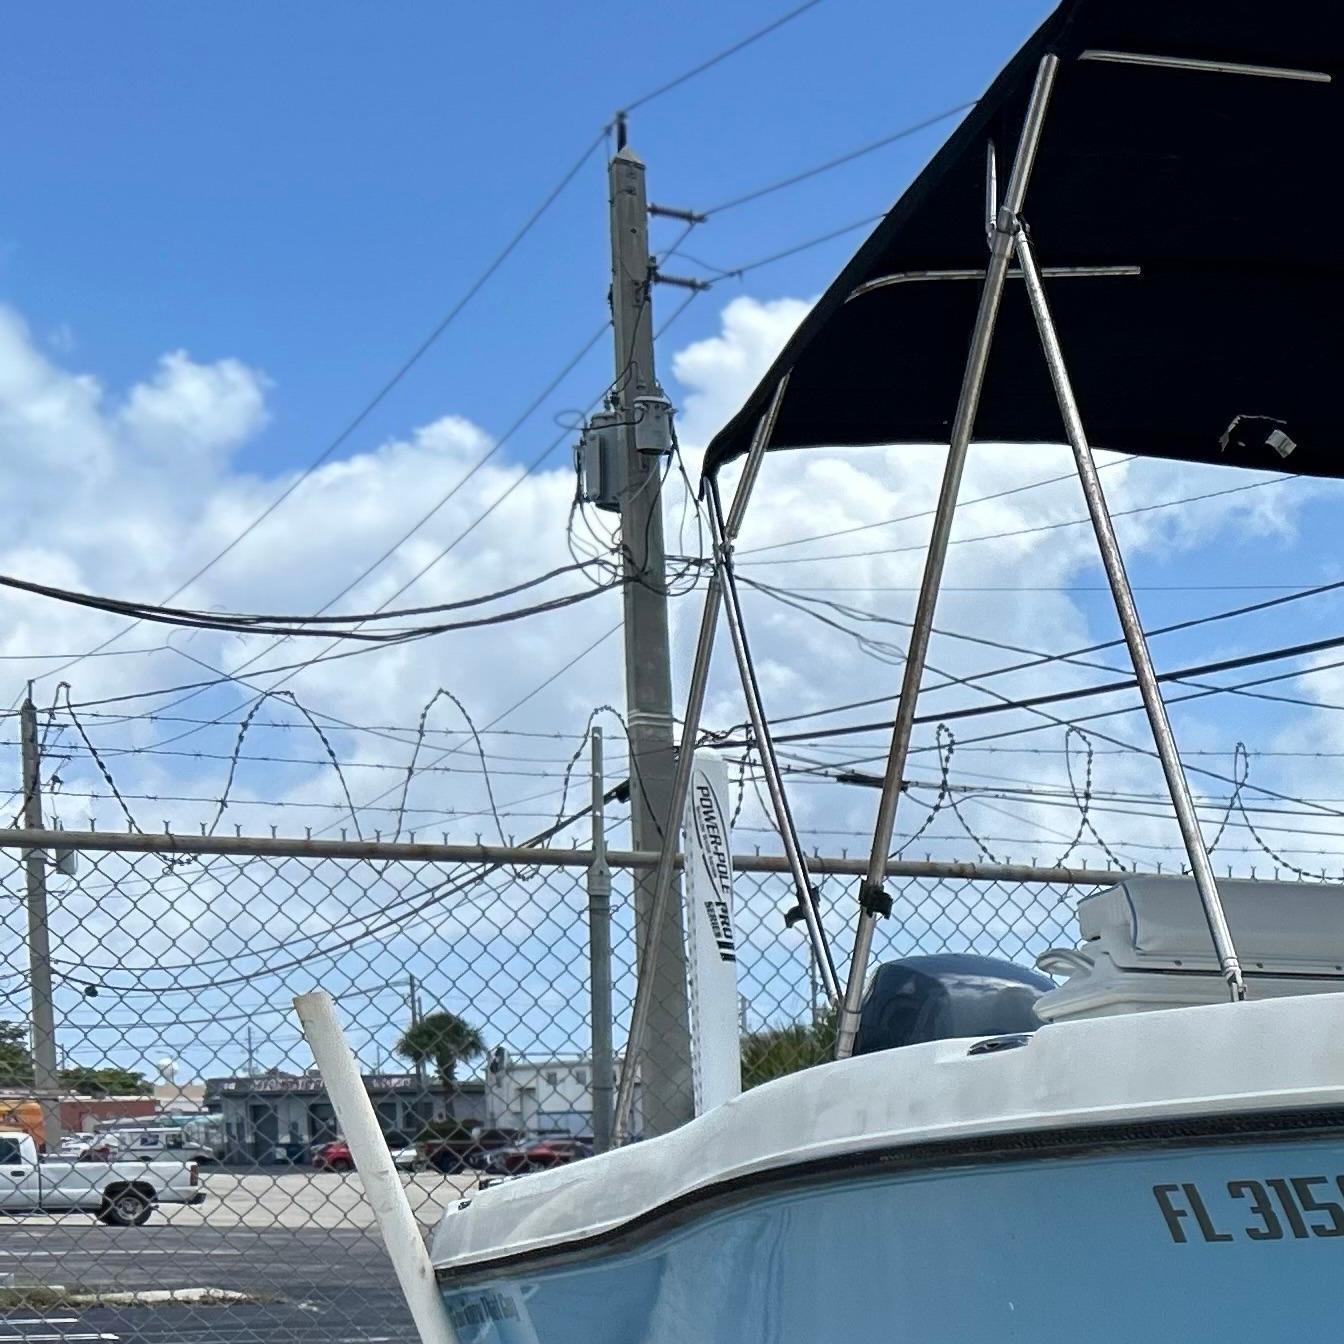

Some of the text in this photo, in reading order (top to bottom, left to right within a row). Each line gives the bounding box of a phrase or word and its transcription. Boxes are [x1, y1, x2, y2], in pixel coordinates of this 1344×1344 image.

[696, 786, 730, 895] POWER-POLE
[716, 902, 734, 941] PRO
[1152, 1183, 1234, 1243] FL
